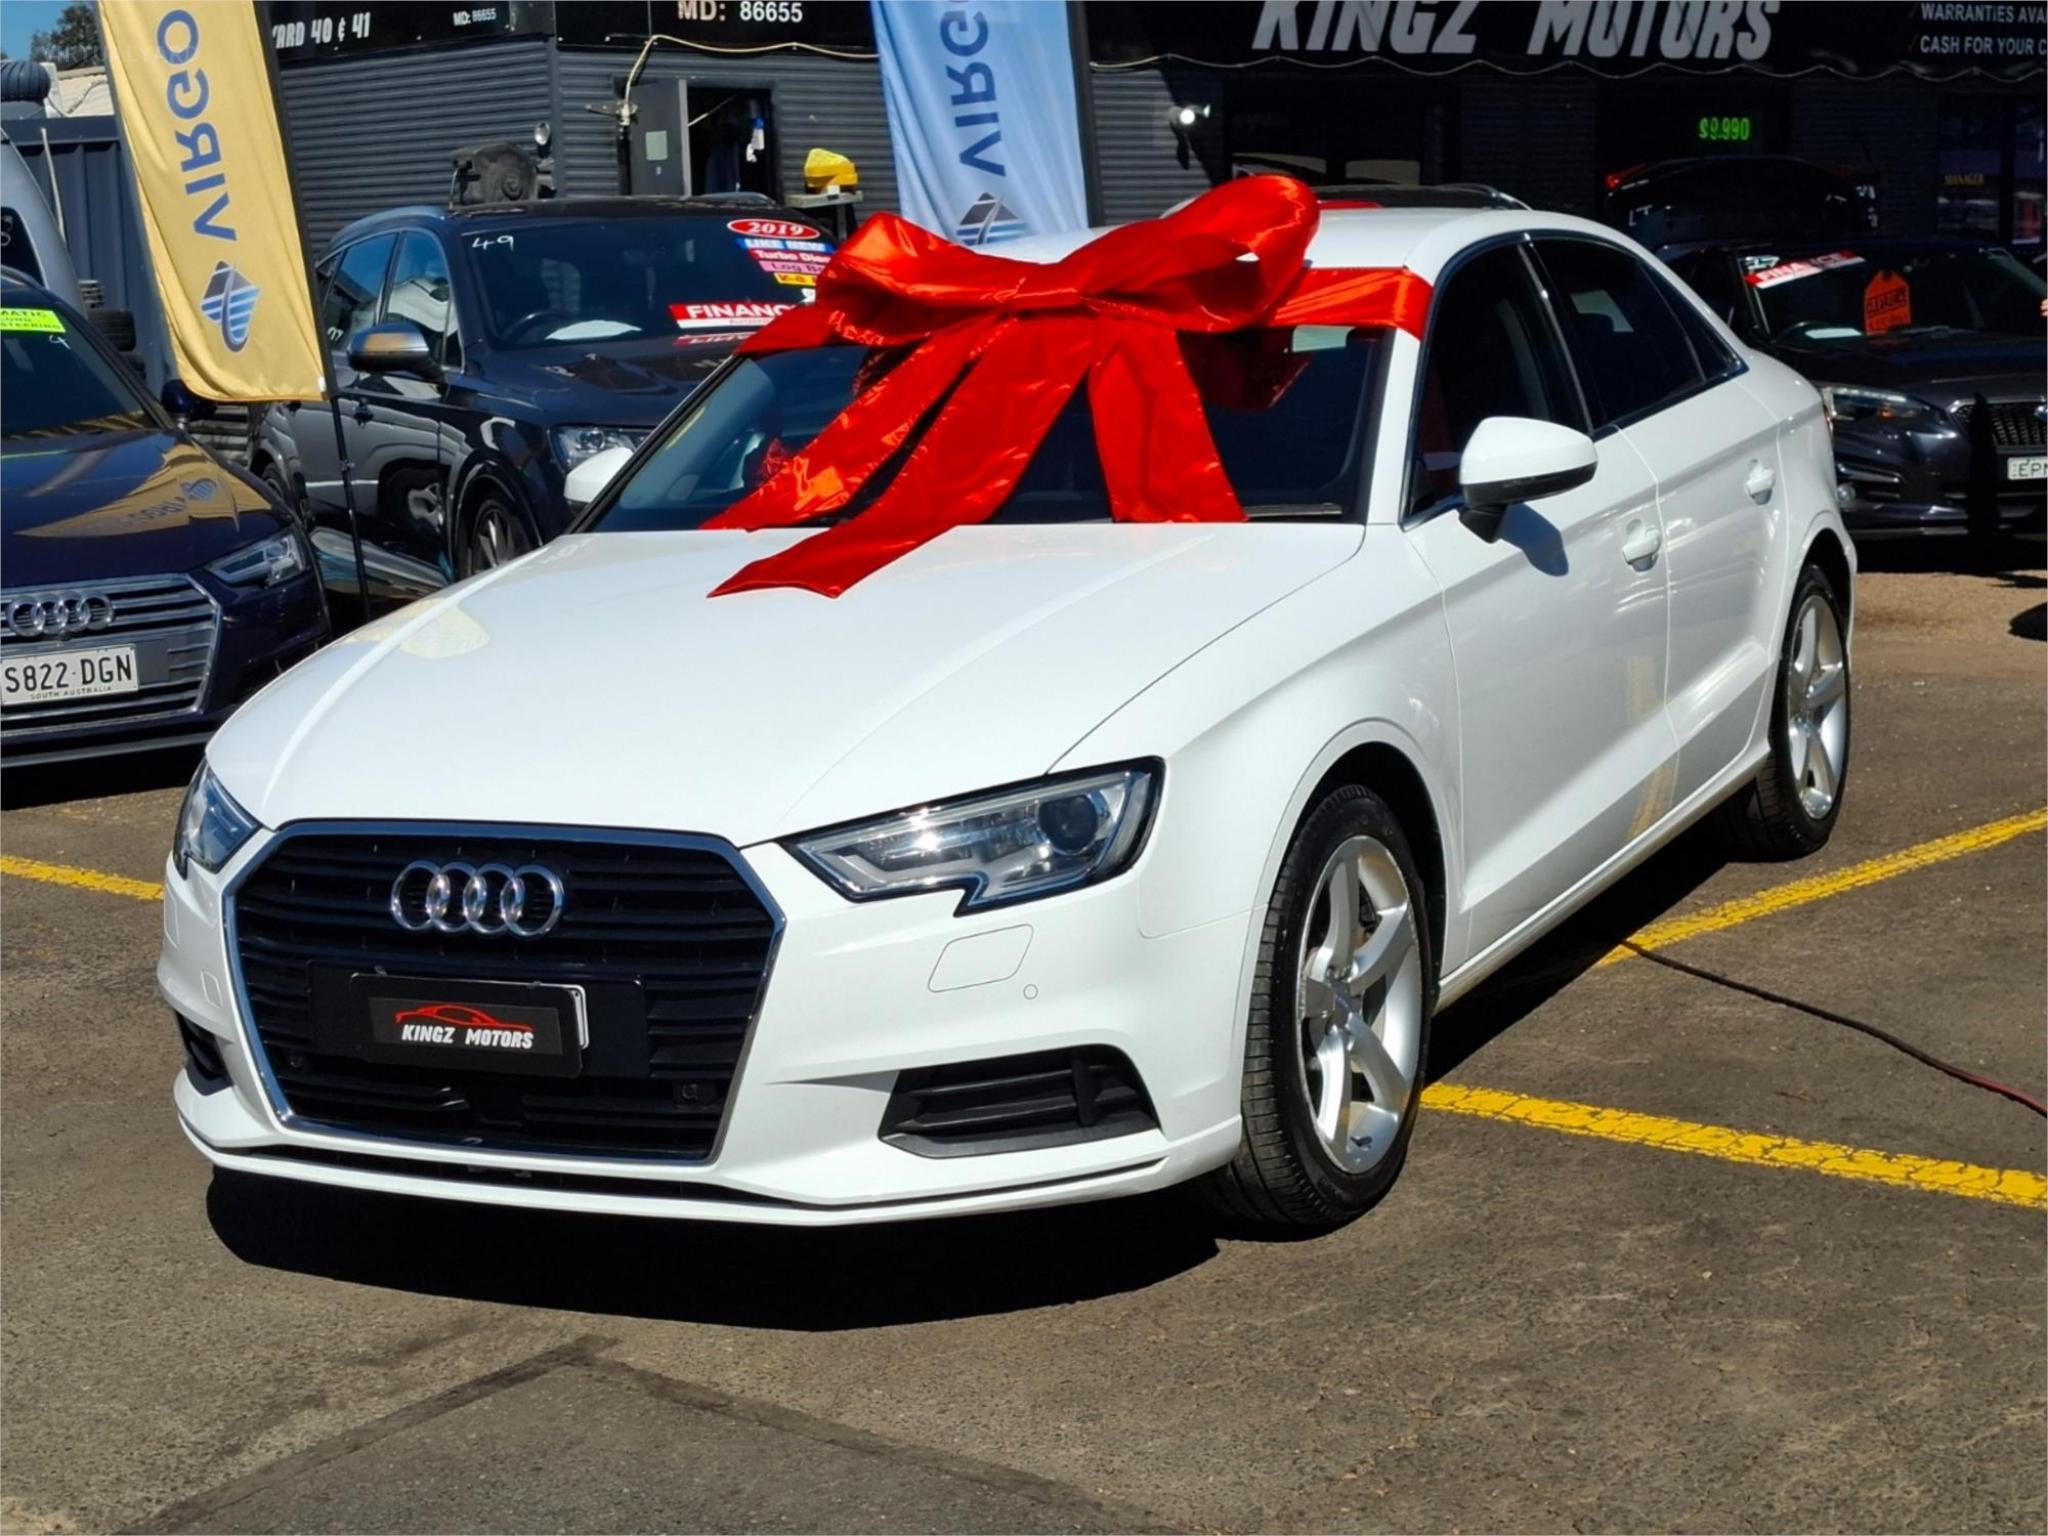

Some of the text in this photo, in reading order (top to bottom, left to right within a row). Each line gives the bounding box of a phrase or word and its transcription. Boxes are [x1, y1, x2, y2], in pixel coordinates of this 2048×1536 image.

[452, 11, 471, 26] MD:
[678, 1, 803, 22] MD: 86655
[311, 17, 332, 44] 40
[352, 12, 371, 39] 41
[1251, 1, 1782, 60] KINGZ MOTORS
[1920, 35, 1960, 53] CASH
[1964, 36, 1994, 54] FOR
[1997, 38, 2035, 55] YOUR
[747, 221, 804, 236] 2019
[4, 654, 132, 693] S822 DGN
[30, 686, 112, 700] SOUTH AUSTRALIA
[401, 1024, 534, 1049] KINGZ MOTORS
